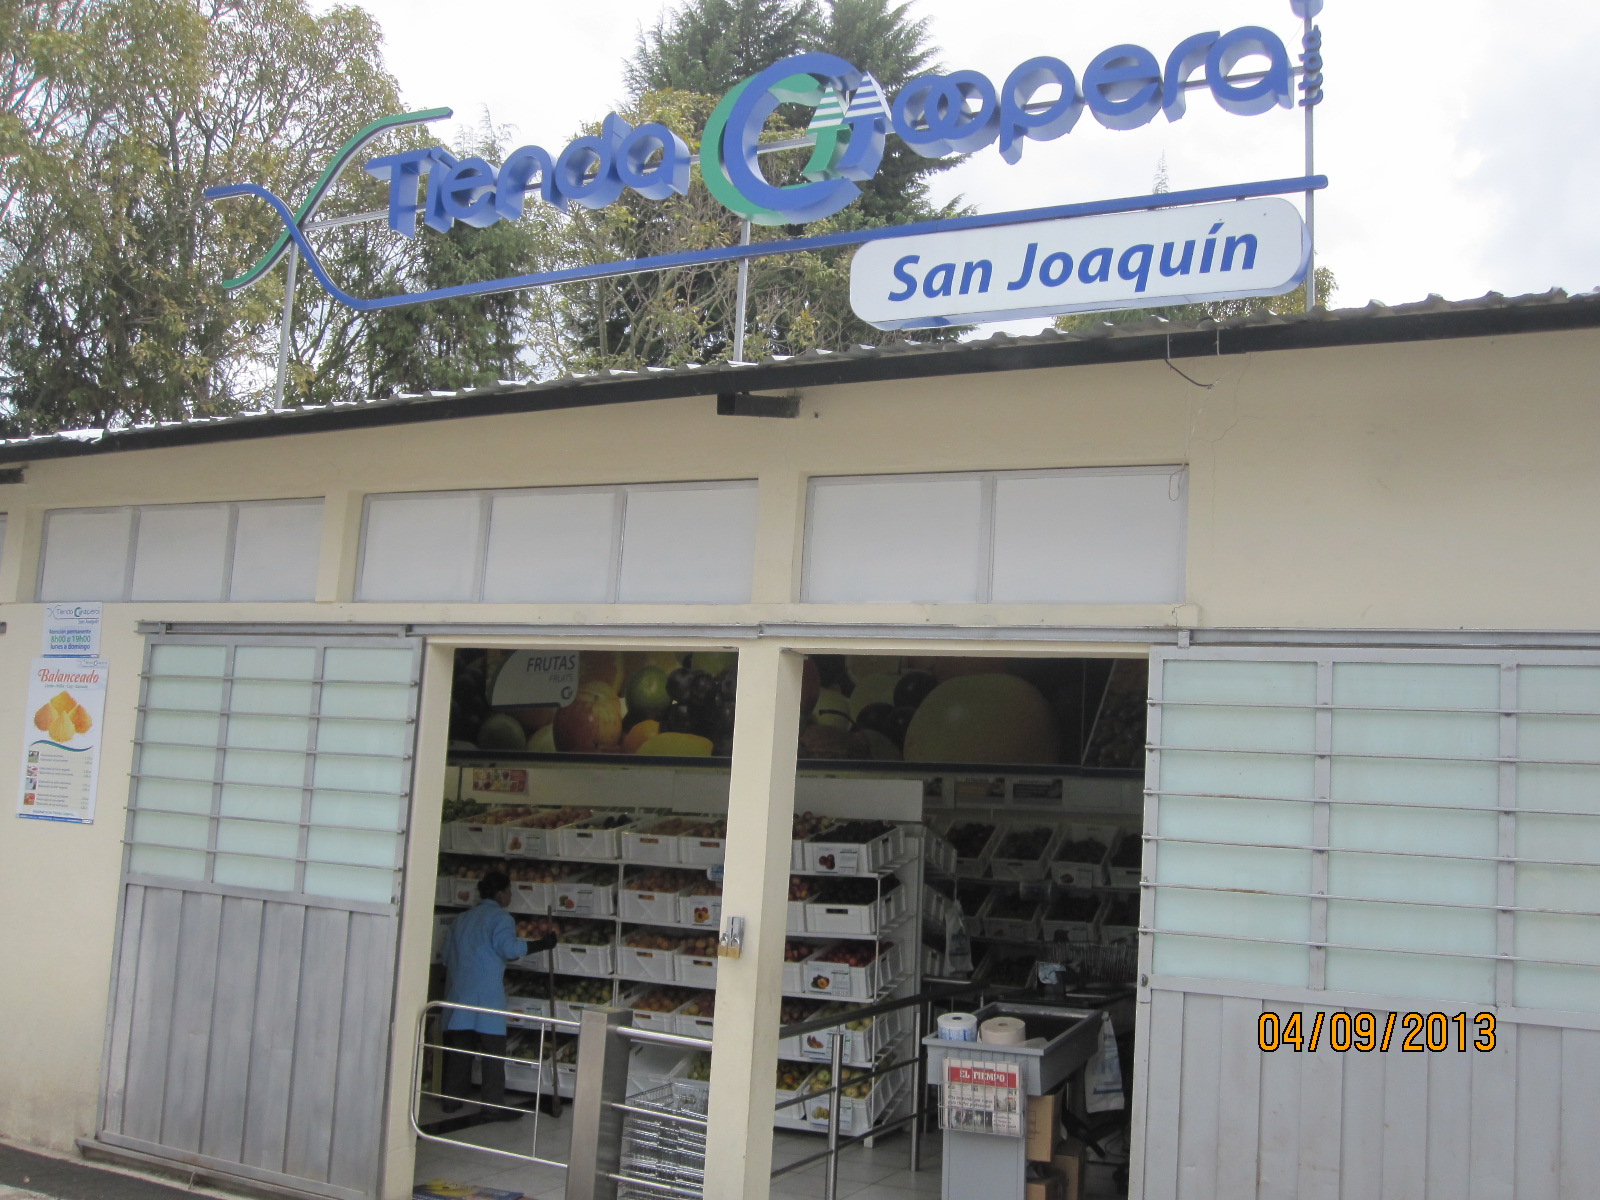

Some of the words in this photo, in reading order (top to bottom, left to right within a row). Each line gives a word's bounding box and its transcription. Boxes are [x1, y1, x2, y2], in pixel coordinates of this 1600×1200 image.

[364, 111, 690, 239] Tienda
[700, 24, 1295, 227] Coopera
[887, 254, 993, 302] San
[1007, 222, 1258, 293] Joaquín
[51, 635, 66, 643] 8h00
[72, 635, 91, 643] 19h00
[68, 643, 90, 651] domingo
[526, 654, 576, 673] FRUTAS
[38, 668, 99, 683] Balanceado
[960, 1069, 970, 1079] EL
[973, 1071, 1006, 1082] TIEMPO
